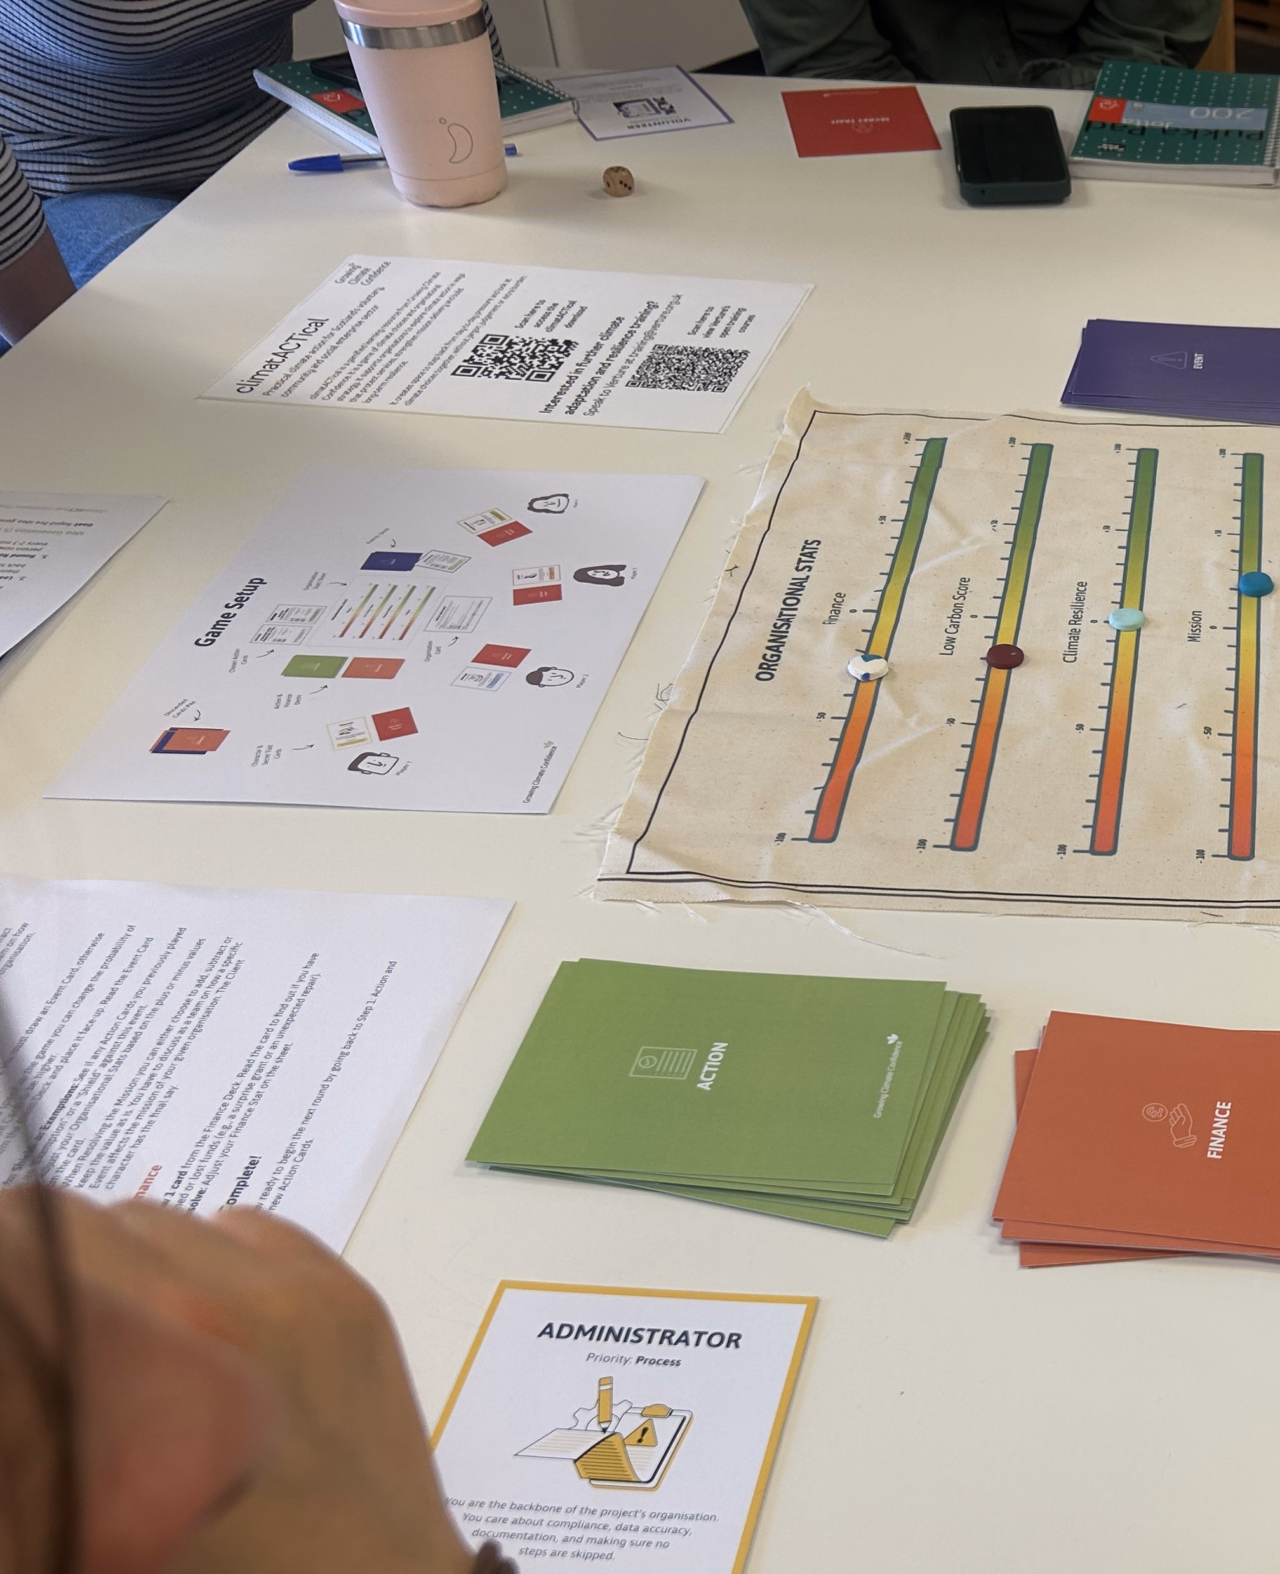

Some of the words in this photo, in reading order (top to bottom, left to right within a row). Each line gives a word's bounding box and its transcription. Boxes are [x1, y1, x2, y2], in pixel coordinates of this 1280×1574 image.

[1188, 106, 1253, 119] 200
[1082, 119, 1148, 136] Pad
[1158, 123, 1265, 144] Pukka
[235, 317, 329, 394] climatACTical
[1192, 352, 1204, 369] EVENT
[951, 576, 971, 601] Score
[1067, 580, 1088, 625] Resilience
[193, 611, 237, 647] Game
[223, 577, 268, 609] Setup
[754, 574, 810, 681] ORGANISATIONAL
[794, 538, 822, 572] STATS
[821, 591, 846, 624] Finance
[944, 601, 965, 634] Carbon
[1186, 609, 1202, 642] Mission
[938, 635, 957, 655] Low
[1062, 627, 1081, 663] Climate
[696, 1041, 728, 1090] ACTION
[886, 1040, 903, 1072] Confidence
[88, 1165, 112, 1189] Event
[106, 1136, 131, 1164] affects
[123, 1121, 140, 1135] the
[134, 1090, 160, 1120] mission
[155, 1080, 166, 1089] of
[161, 1062, 177, 1080] your
[172, 1040, 192, 1061] given
[187, 995, 222, 1040] organisation.
[214, 980, 232, 994] The
[224, 959, 245, 980] Client
[879, 1070, 894, 1093] Climate
[872, 1092, 890, 1118] Growing
[104, 1150, 135, 1189] character
[128, 1134, 146, 1148] has
[140, 1119, 156, 1132] the
[148, 1100, 169, 1118] final
[162, 1084, 179, 1098] say.
[1206, 1100, 1232, 1159] FINANCE
[225, 1155, 262, 1206] omplete!
[536, 1322, 742, 1349] ADMINISTRATOR
[634, 1355, 681, 1367] Process
[442, 1496, 467, 1506] You
[467, 1499, 486, 1508] are
[487, 1499, 507, 1510] the
[508, 1500, 562, 1513] backbone
[564, 1504, 578, 1514] of
[578, 1505, 598, 1516] the
[598, 1508, 646, 1519] project's
[648, 1511, 719, 1522] organisation.
[462, 1512, 483, 1522] You
[484, 1515, 509, 1524] care
[510, 1516, 544, 1527] about
[546, 1519, 611, 1532] compliance,
[614, 1522, 640, 1533] data
[641, 1525, 692, 1536] accuracy,
[470, 1527, 558, 1544] documentation,
[561, 1534, 584, 1544] and
[584, 1535, 627, 1549] making
[629, 1539, 653, 1548] sure
[654, 1540, 670, 1549] no
[518, 1546, 547, 1558] steps
[549, 1549, 568, 1558] are
[569, 1549, 615, 1562] skipped.
